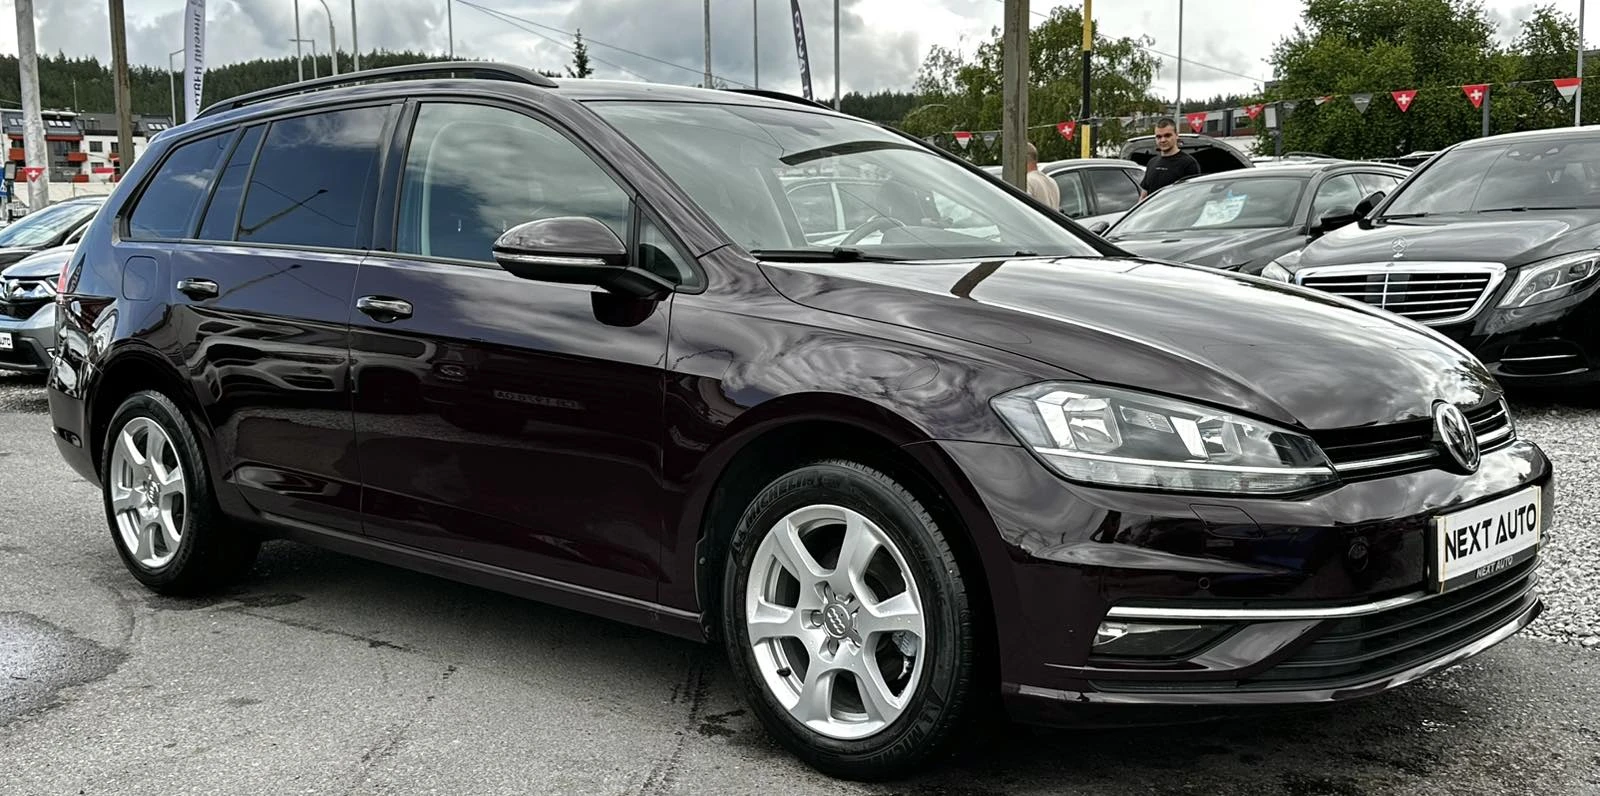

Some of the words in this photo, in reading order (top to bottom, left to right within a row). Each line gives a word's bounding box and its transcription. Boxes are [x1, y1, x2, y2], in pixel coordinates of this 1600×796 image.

[1445, 518, 1493, 563] NEXT
[1495, 503, 1537, 545] AUTO
[1476, 564, 1496, 579] NEXT
[1495, 556, 1514, 572] AUTO
